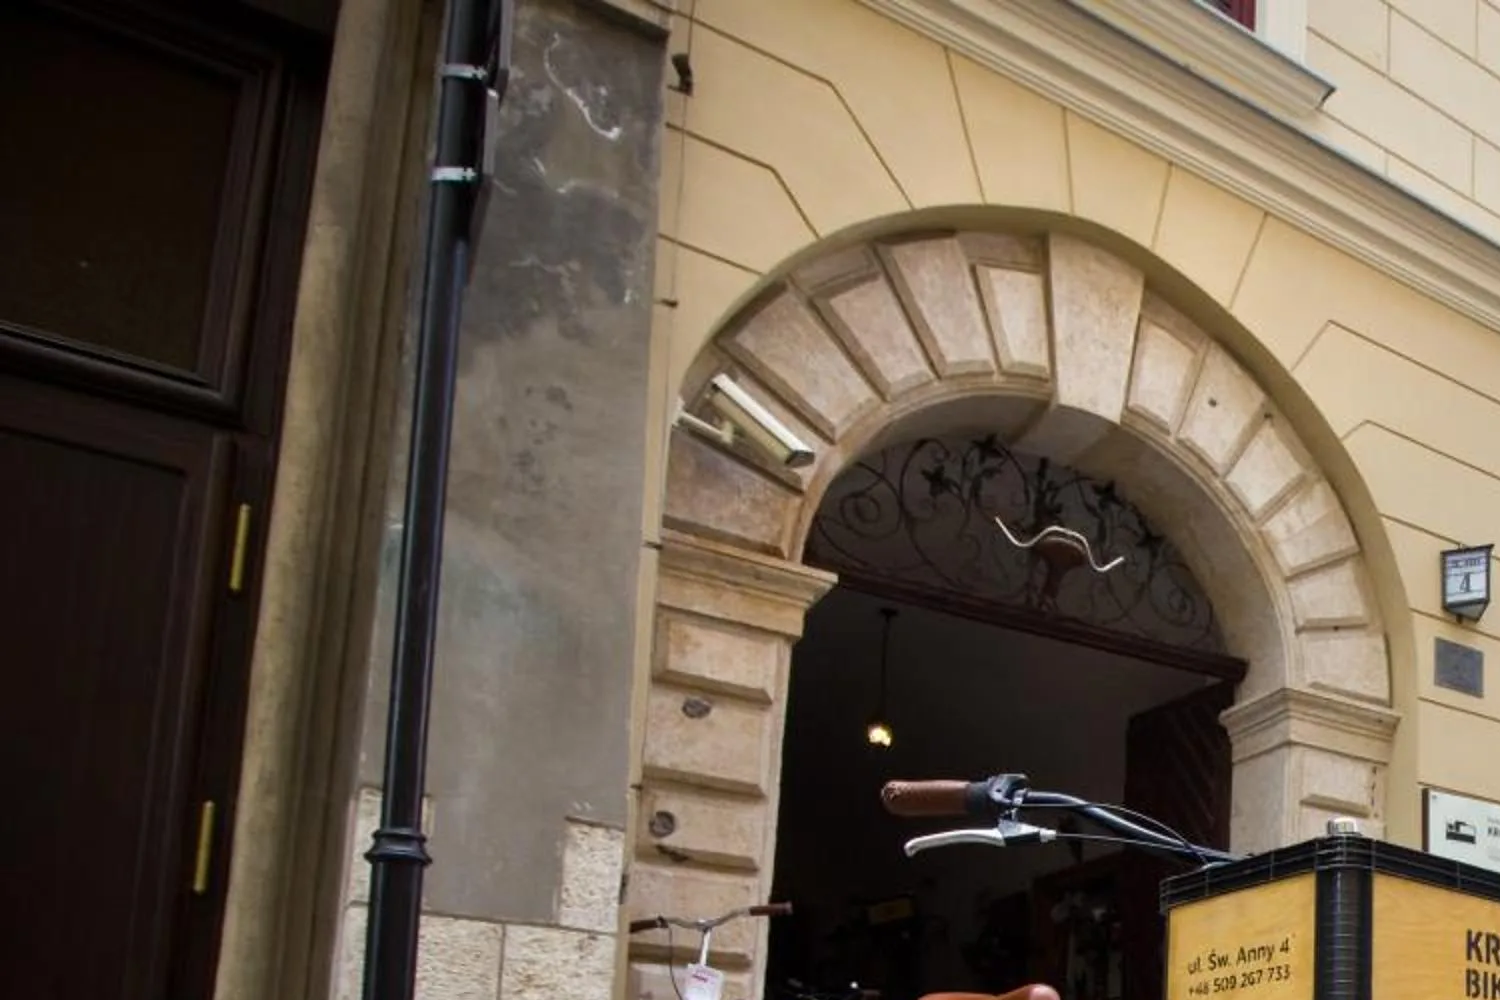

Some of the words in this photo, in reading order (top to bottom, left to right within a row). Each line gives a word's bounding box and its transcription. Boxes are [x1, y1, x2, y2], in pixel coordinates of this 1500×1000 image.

[1459, 571, 1471, 592] 4
[1236, 943, 1275, 966] Anny
[1279, 937, 1290, 954] 4
[1213, 975, 1237, 993] 509
[1267, 963, 1290, 982] 733
